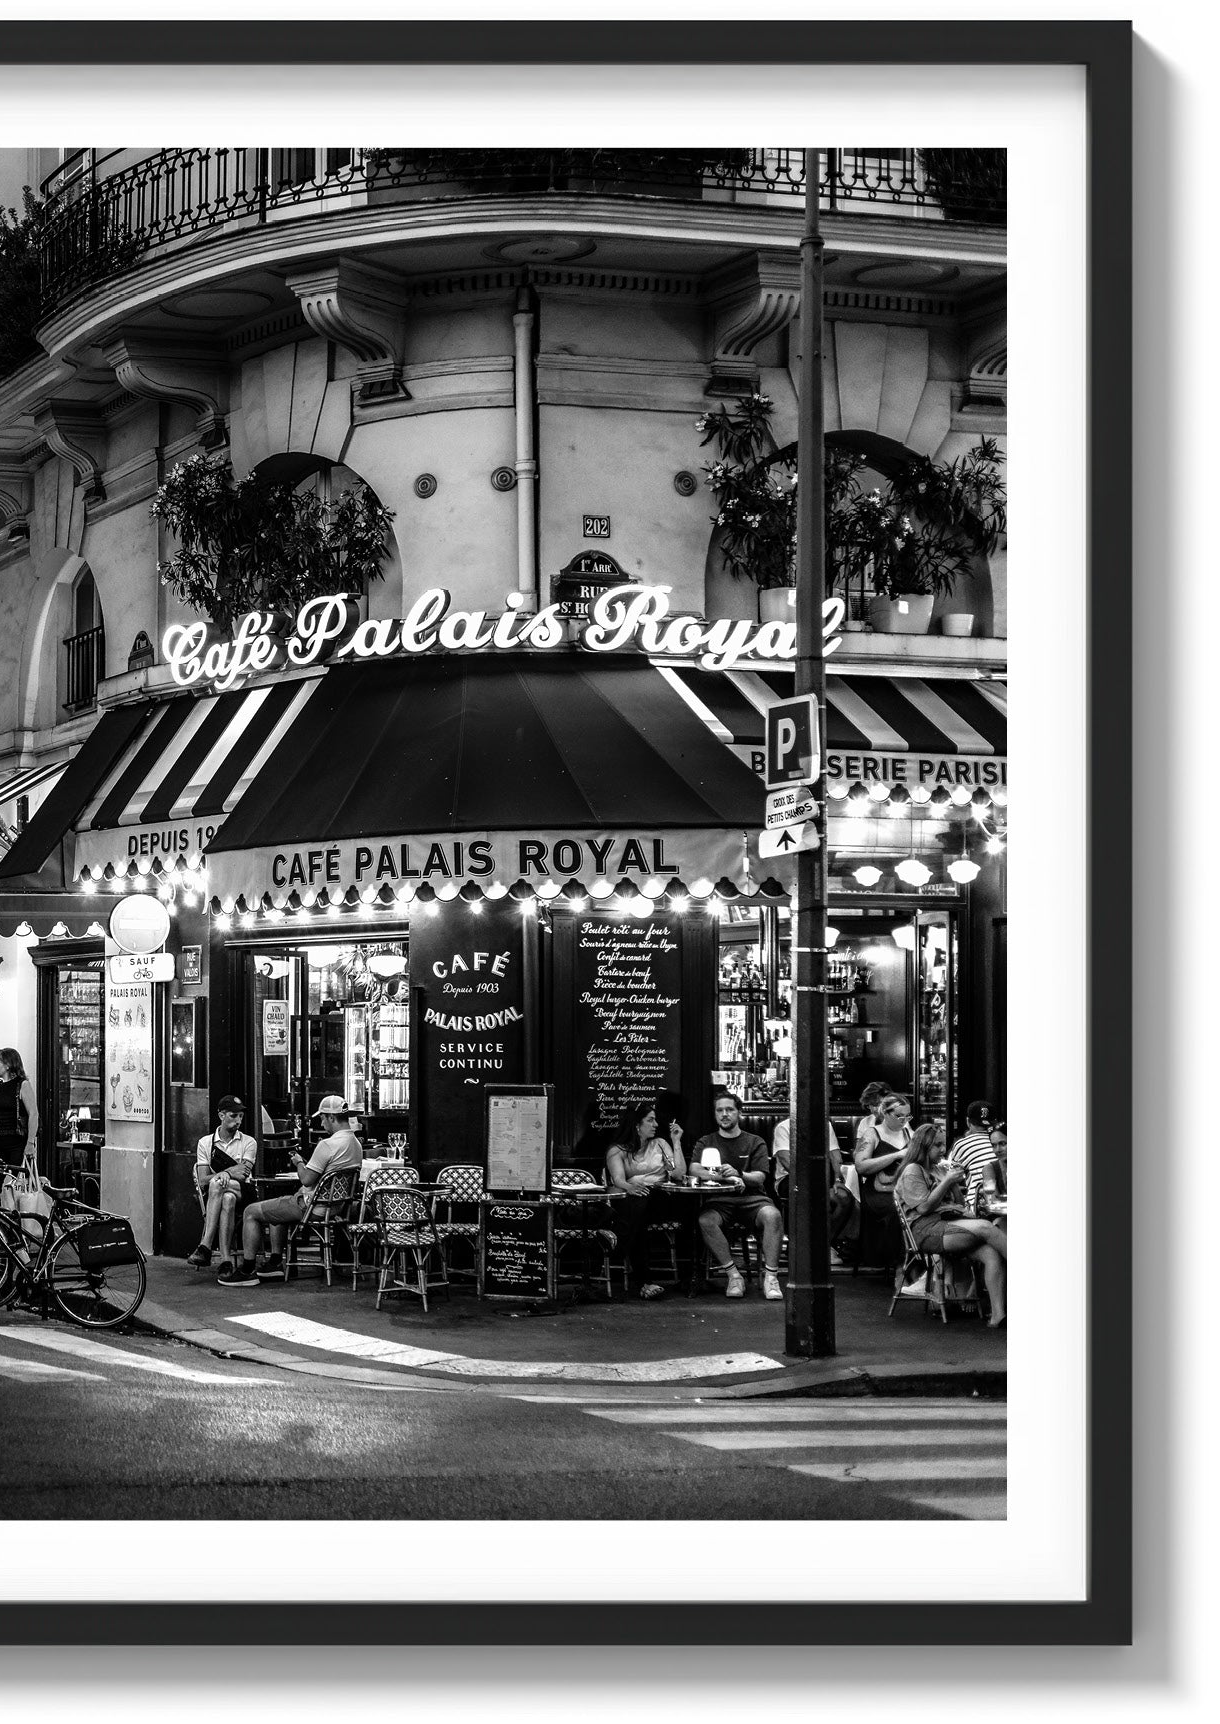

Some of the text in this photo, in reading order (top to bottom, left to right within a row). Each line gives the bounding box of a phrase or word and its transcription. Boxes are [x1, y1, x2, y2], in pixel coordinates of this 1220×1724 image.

[586, 519, 608, 535] 202
[162, 584, 845, 689] Café Palais Royal
[777, 717, 797, 770] P
[773, 794, 795, 808] CROIX DES
[768, 802, 813, 824] PETITS CHAMPS
[128, 825, 222, 857] DEPUIS 19
[272, 839, 681, 888] CAFÉ PALAIS ROYAL
[581, 922, 611, 934] Poulet
[645, 923, 671, 940] four
[579, 938, 604, 947] Souris
[129, 957, 155, 966] SAUF
[186, 952, 196, 961] RUE
[597, 951, 620, 966] Confit
[626, 953, 651, 961] canard
[183, 968, 198, 977] VALOIS
[432, 951, 511, 979] CAFÉ
[442, 982, 499, 998] Depuis 1903
[627, 979, 656, 989] boucher
[110, 988, 147, 998] PALAIS ROYAL
[579, 992, 606, 1007] Royal
[656, 994, 680, 1007] burger
[424, 1006, 523, 1031] PALAIS ROYAL
[613, 1032, 626, 1042] Les
[440, 1043, 504, 1053] SERVICE
[440, 1059, 503, 1069] CONTINU
